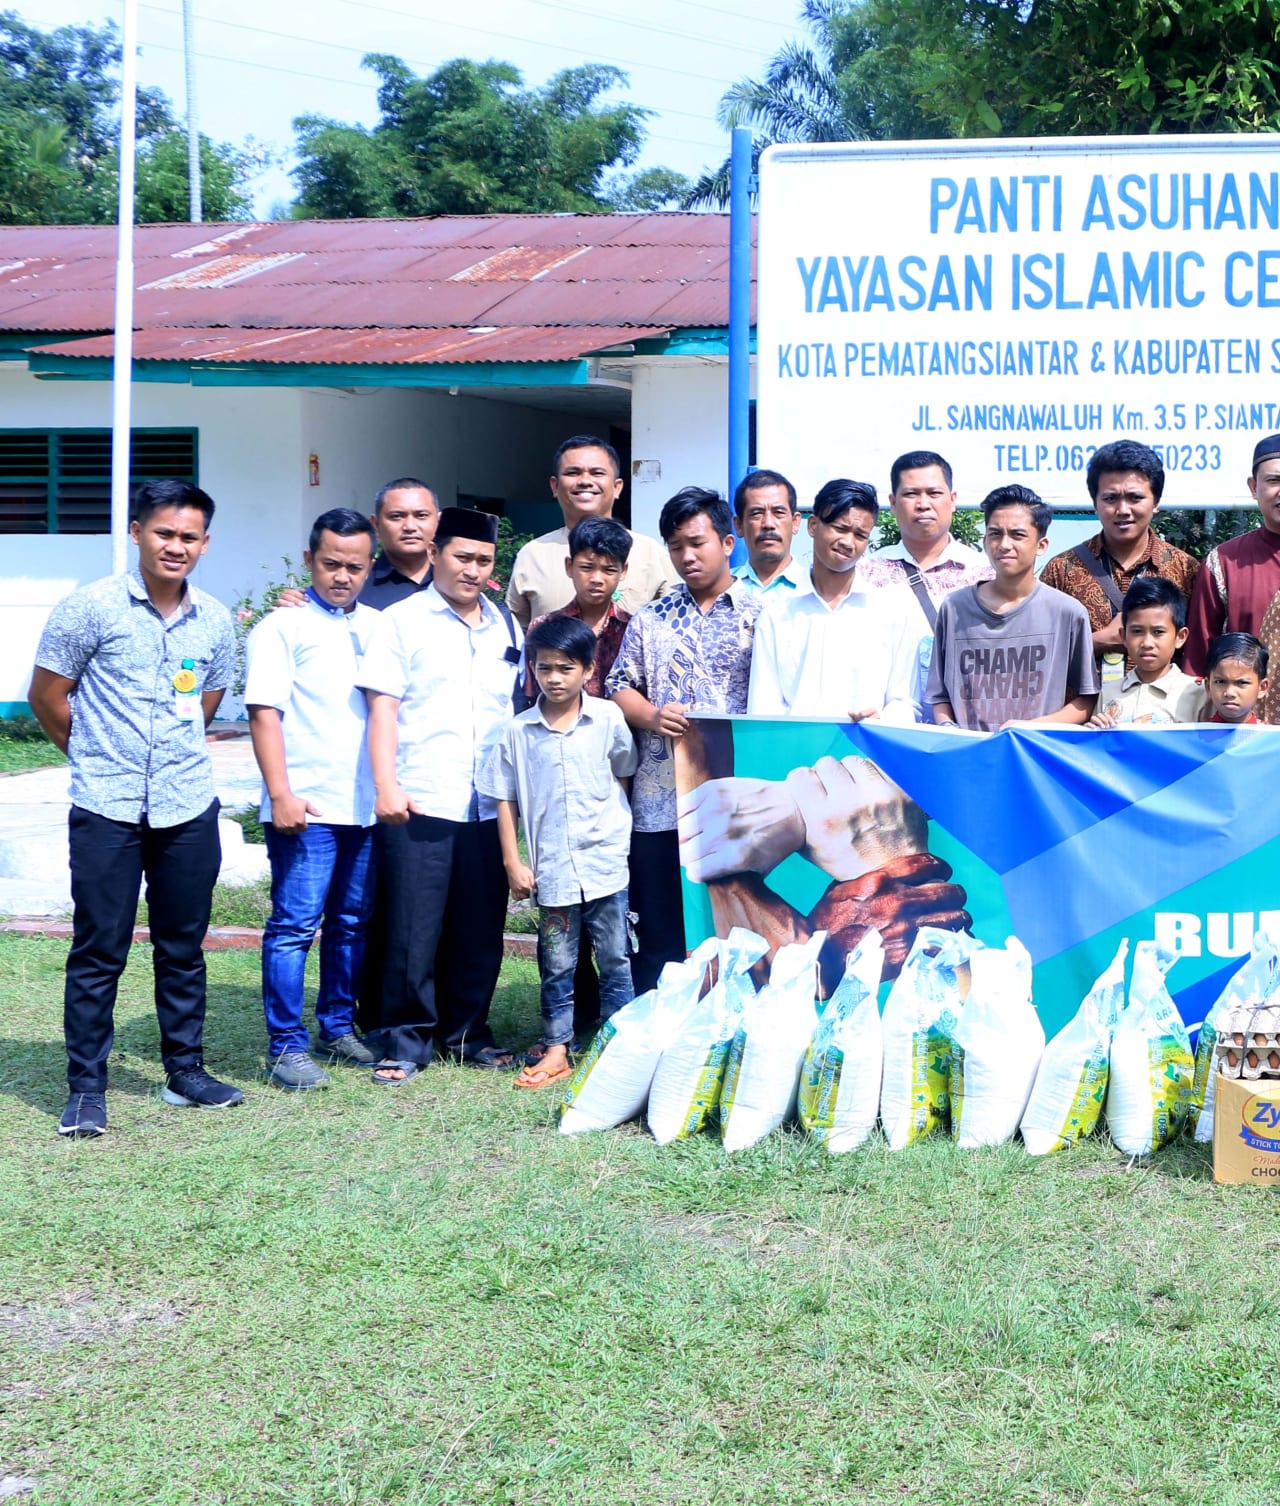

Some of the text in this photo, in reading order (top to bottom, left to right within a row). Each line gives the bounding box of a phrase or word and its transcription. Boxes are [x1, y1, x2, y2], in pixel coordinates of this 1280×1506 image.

[930, 172, 1280, 234] PANTI ASUHAN
[796, 253, 993, 313] YAYASAN
[1011, 250, 1206, 310] ISLAMIC
[778, 342, 838, 378] KOTA
[844, 340, 1079, 377] PEMATANGSIANTAR
[1090, 341, 1106, 374] &
[1113, 338, 1261, 375] KABUPATEN
[911, 405, 942, 432] JL.
[946, 403, 1103, 432] SANGNAWALUH
[1112, 403, 1149, 431] Km.
[960, 645, 1047, 675] CHAMP
[1251, 1138, 1270, 1149] STICK
